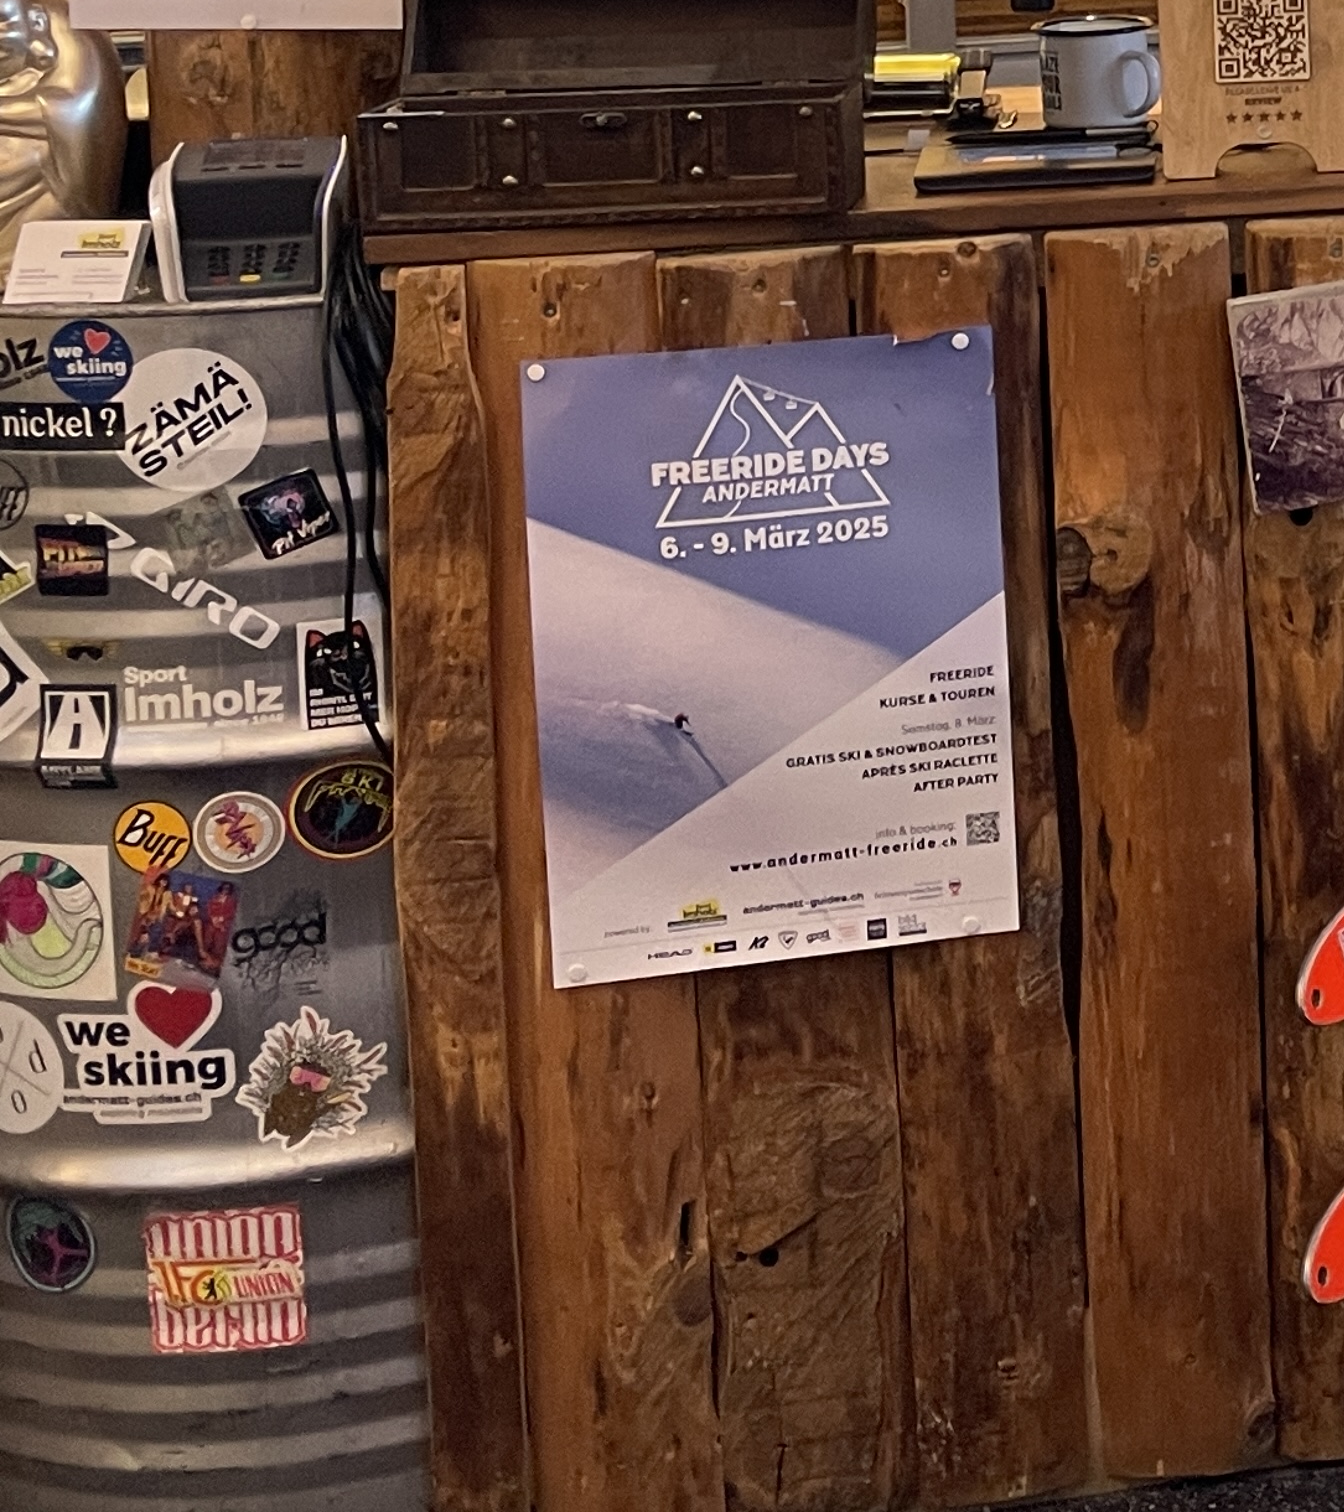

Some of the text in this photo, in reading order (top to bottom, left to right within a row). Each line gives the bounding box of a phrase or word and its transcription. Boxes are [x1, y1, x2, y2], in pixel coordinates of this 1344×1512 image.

[53, 346, 84, 359] we
[65, 357, 128, 378] skiing
[1, 406, 95, 438] nickel
[125, 360, 240, 457] ZÄMÄ
[138, 388, 253, 478] STEIL!
[651, 441, 890, 487] FREERIDE DAYS
[702, 473, 836, 504] ANDERMATT
[659, 536, 687, 559] 6.
[711, 531, 737, 555] 9.
[744, 523, 811, 553] März
[816, 514, 889, 544] 2025
[130, 546, 281, 650] GIRO
[123, 664, 188, 688] Sport
[929, 664, 995, 683] FREERIDE
[123, 679, 285, 723] Imholz
[879, 693, 926, 709] KURSE
[941, 686, 996, 702] TOUREN
[785, 752, 836, 769] GRATIS
[838, 750, 861, 763] SKI
[875, 733, 997, 759] SNOWBOARDTEST
[909, 761, 931, 773] SKI
[933, 752, 998, 771] RACLETTE
[913, 772, 999, 793] AFTER PARTY
[117, 808, 189, 867] Buff
[729, 835, 958, 874] www.andermatt-freeride.ch
[647, 948, 693, 960] HEAD
[64, 1020, 131, 1048] we
[84, 1050, 227, 1091] skiing
